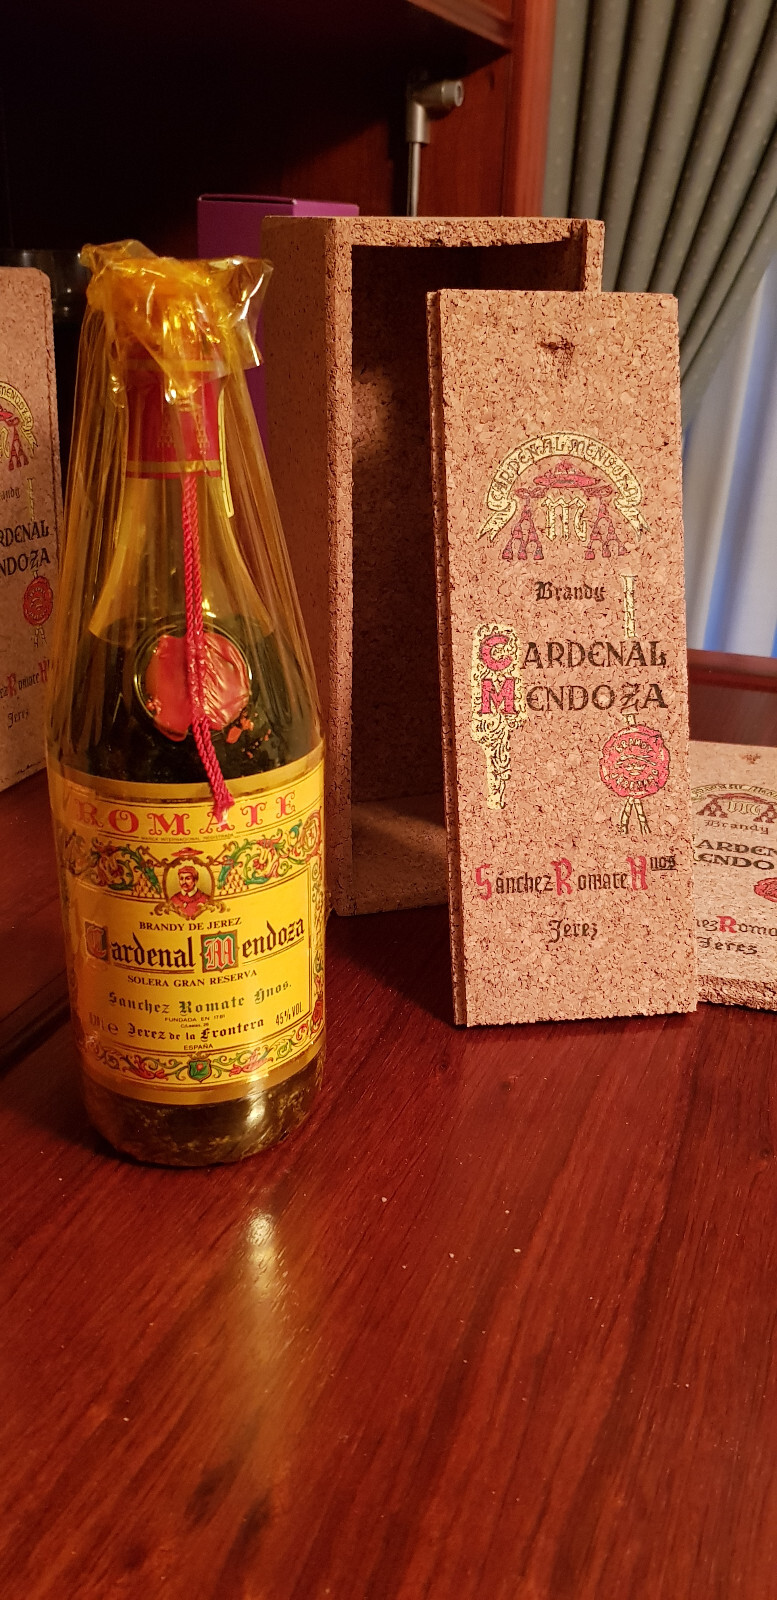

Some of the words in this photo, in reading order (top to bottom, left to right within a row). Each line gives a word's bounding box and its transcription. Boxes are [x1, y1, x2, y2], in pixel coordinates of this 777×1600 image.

[534, 581, 606, 602] Brandy
[480, 633, 667, 671] CARDENAL
[479, 676, 669, 714] MENDOZA
[76, 790, 299, 836] ROMATE
[704, 819, 769, 835] Brandy
[550, 857, 629, 896] Romate
[138, 921, 185, 932] BRANDY
[188, 922, 204, 931] DE
[207, 917, 241, 930] JEREZ
[549, 918, 598, 944] Jerez
[86, 923, 197, 969] Cardenal
[202, 918, 305, 971] Mendoza
[696, 936, 758, 955] Jerez
[127, 975, 170, 987] SOLERA
[173, 978, 205, 988] GRAN
[210, 969, 258, 986] RESERVA
[108, 991, 170, 1015] Sanchez
[179, 996, 245, 1017] Romate
[128, 1022, 166, 1040] Jerez
[169, 1032, 181, 1040] de
[185, 1032, 196, 1040] la
[200, 1018, 265, 1043] Frontera
[183, 1043, 214, 1051] ESPAÑA
